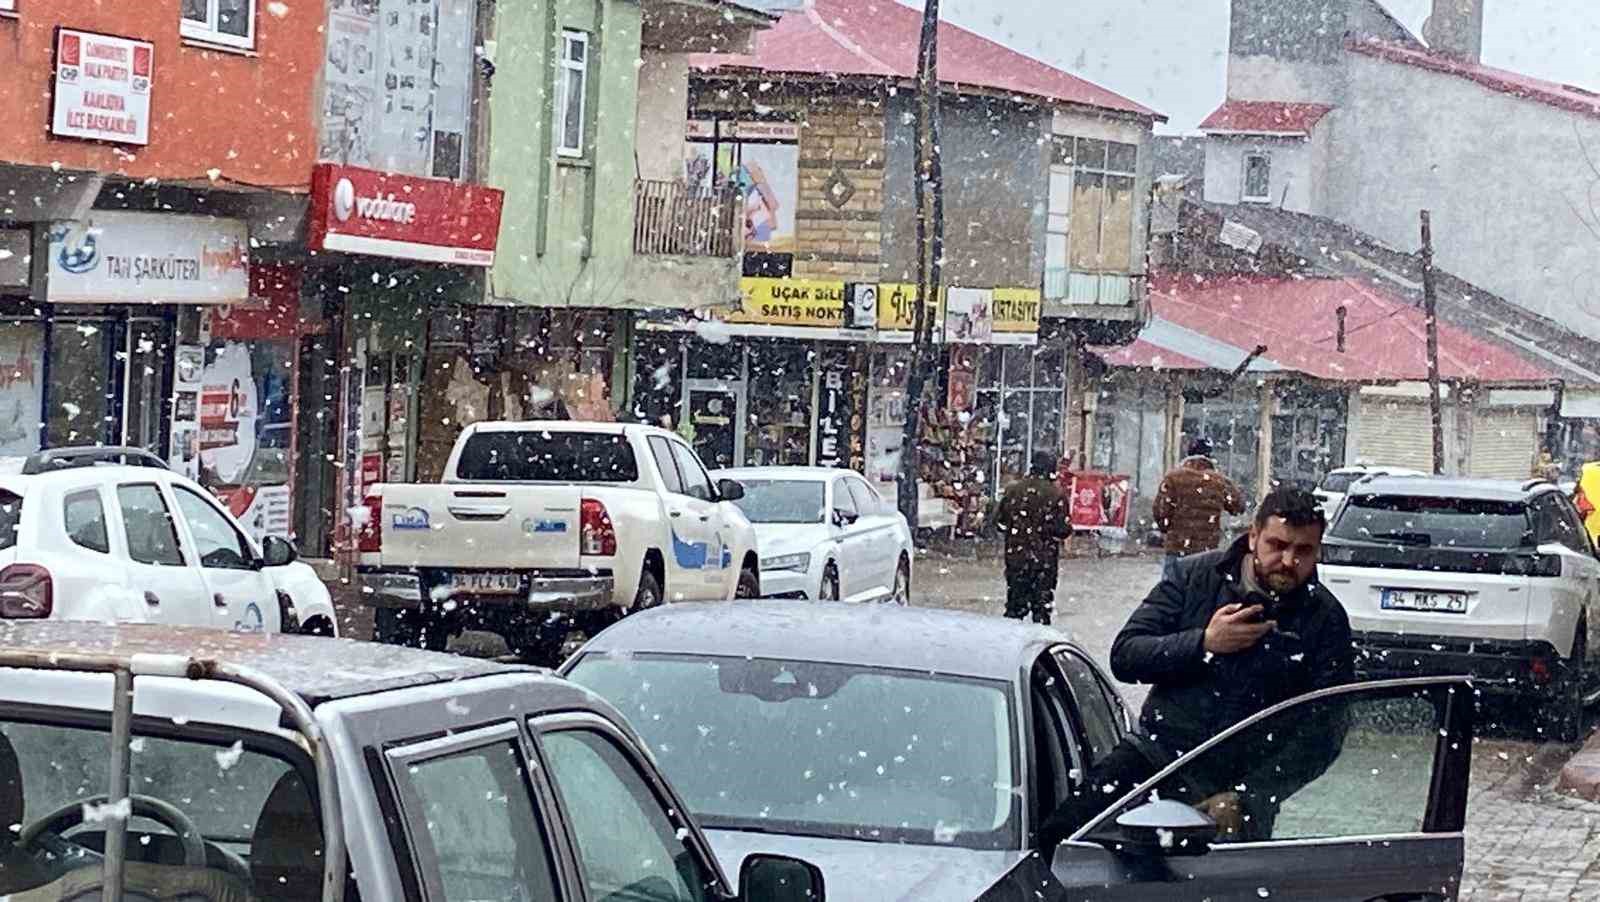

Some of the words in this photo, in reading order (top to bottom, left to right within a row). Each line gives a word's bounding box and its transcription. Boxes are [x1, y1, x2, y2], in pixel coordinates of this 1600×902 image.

[771, 286, 809, 303] UÇAK
[1391, 591, 1406, 606] 34
[1414, 593, 1439, 608] MKS
